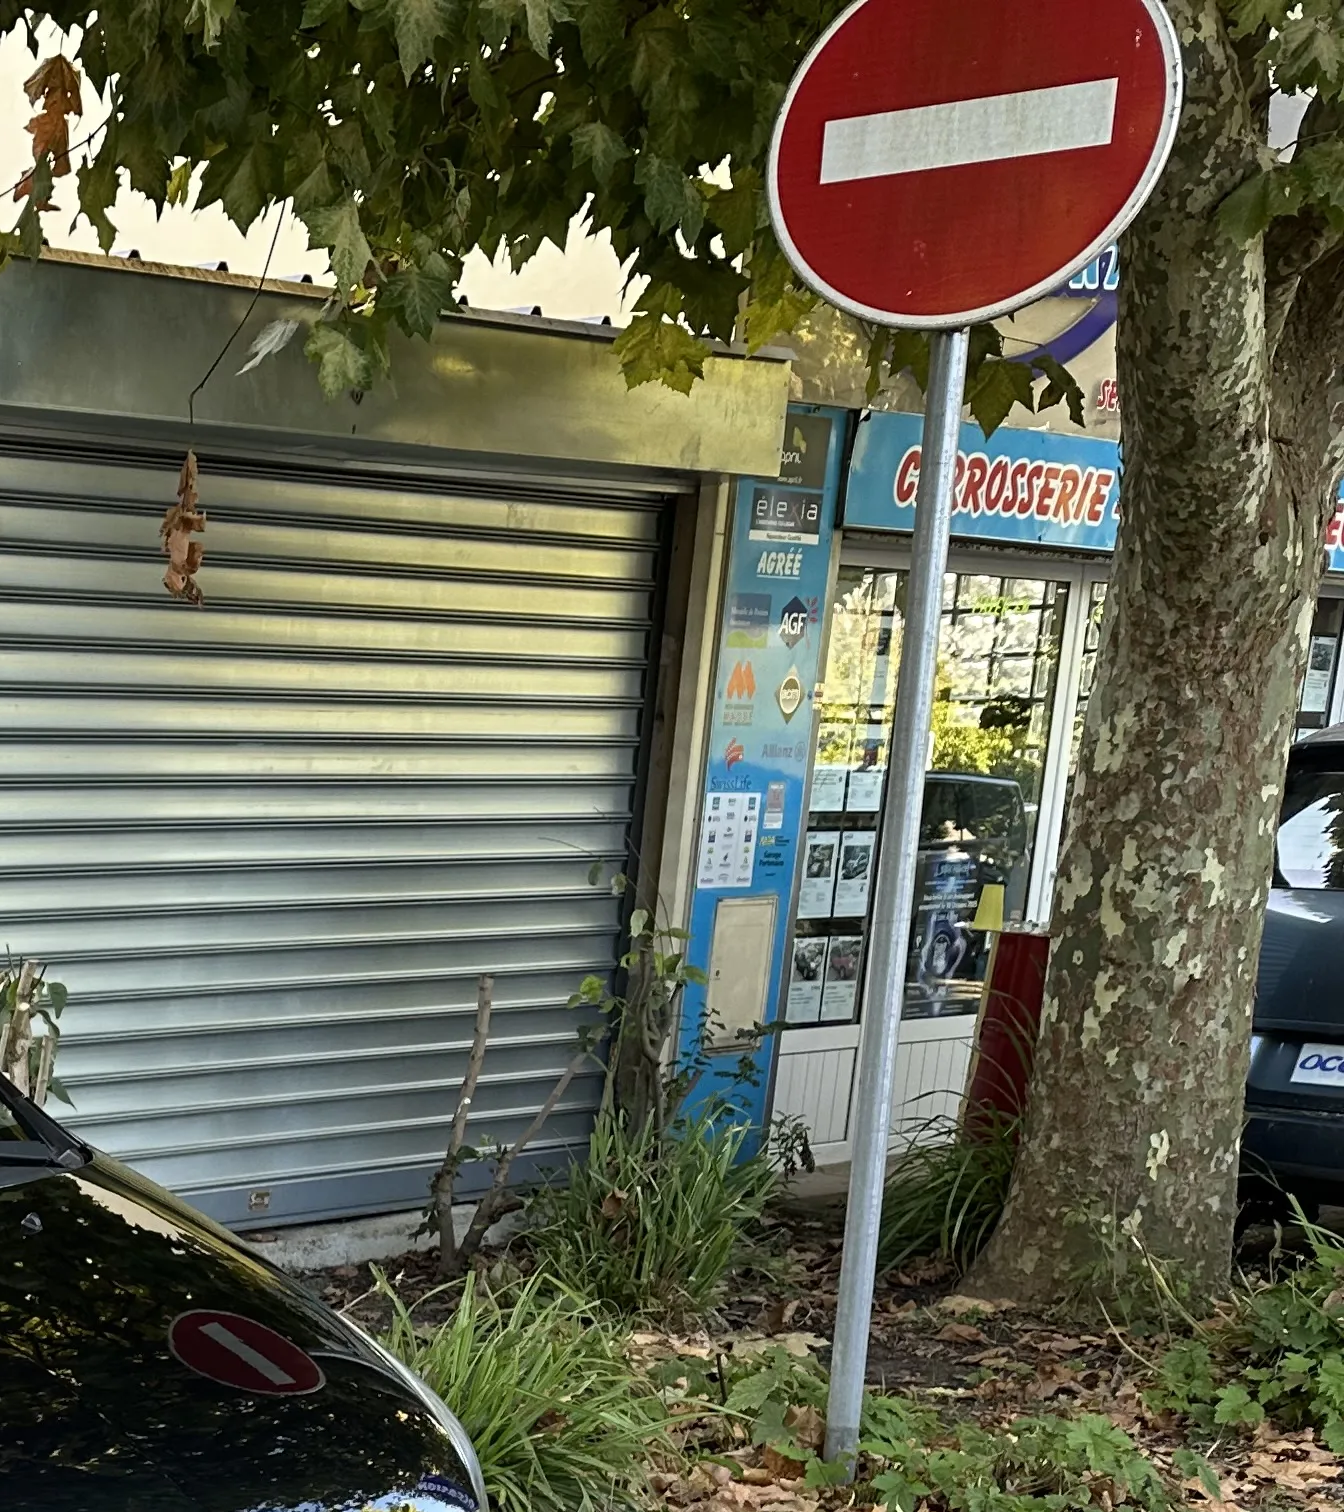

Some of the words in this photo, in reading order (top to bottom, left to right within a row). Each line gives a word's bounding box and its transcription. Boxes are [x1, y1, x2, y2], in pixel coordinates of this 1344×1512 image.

[895, 447, 1115, 526] CRROSSERIE
[756, 547, 804, 577] AGRÉÉ
[777, 612, 808, 636] AGF
[761, 743, 793, 759] Allianz
[1298, 1053, 1344, 1073] OC
